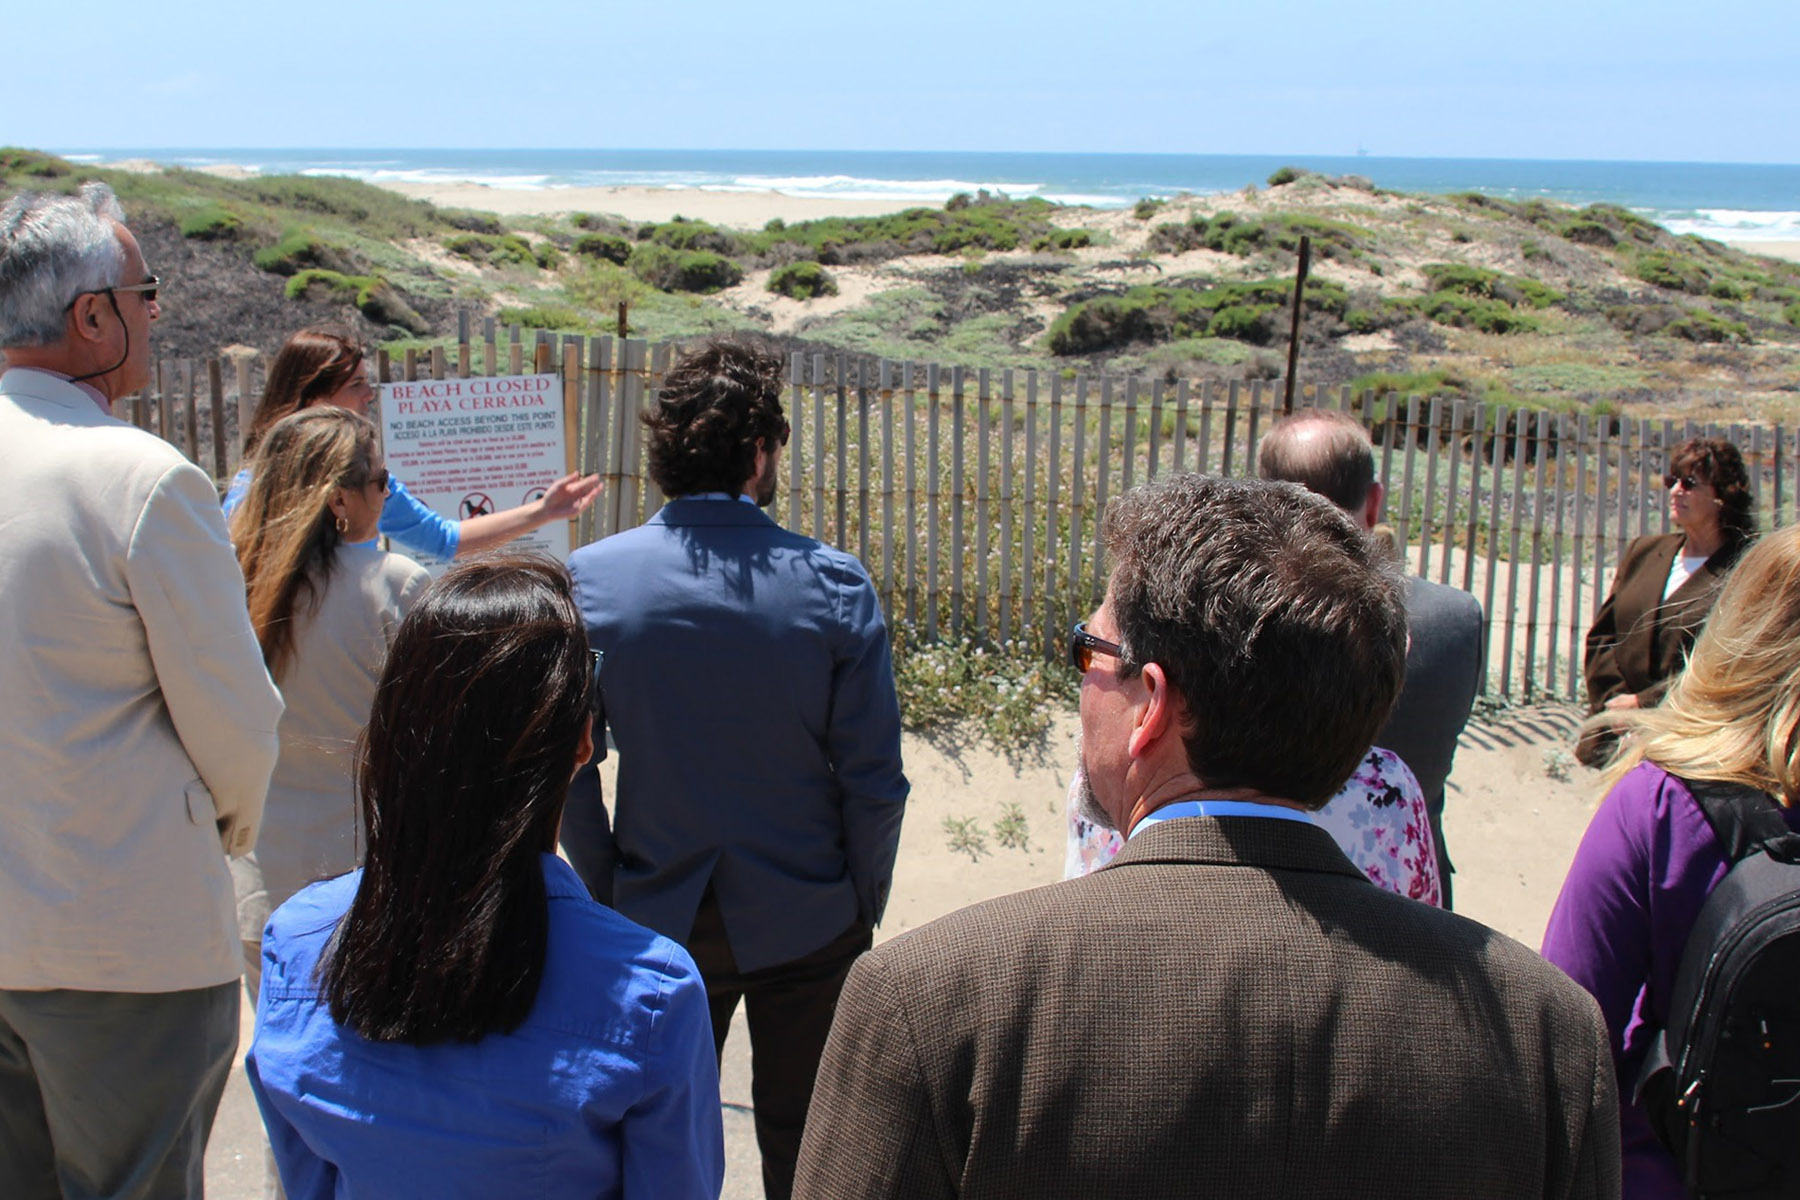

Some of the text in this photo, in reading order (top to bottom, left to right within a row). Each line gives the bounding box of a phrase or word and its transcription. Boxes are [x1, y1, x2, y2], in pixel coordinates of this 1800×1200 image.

[393, 378, 550, 399] BEACH CLOSED
[398, 394, 545, 414] PLAYA CERRADA
[390, 411, 556, 430] NO BEACH ACCESS BEYOND THIS POINT
[428, 430, 437, 438] LA
